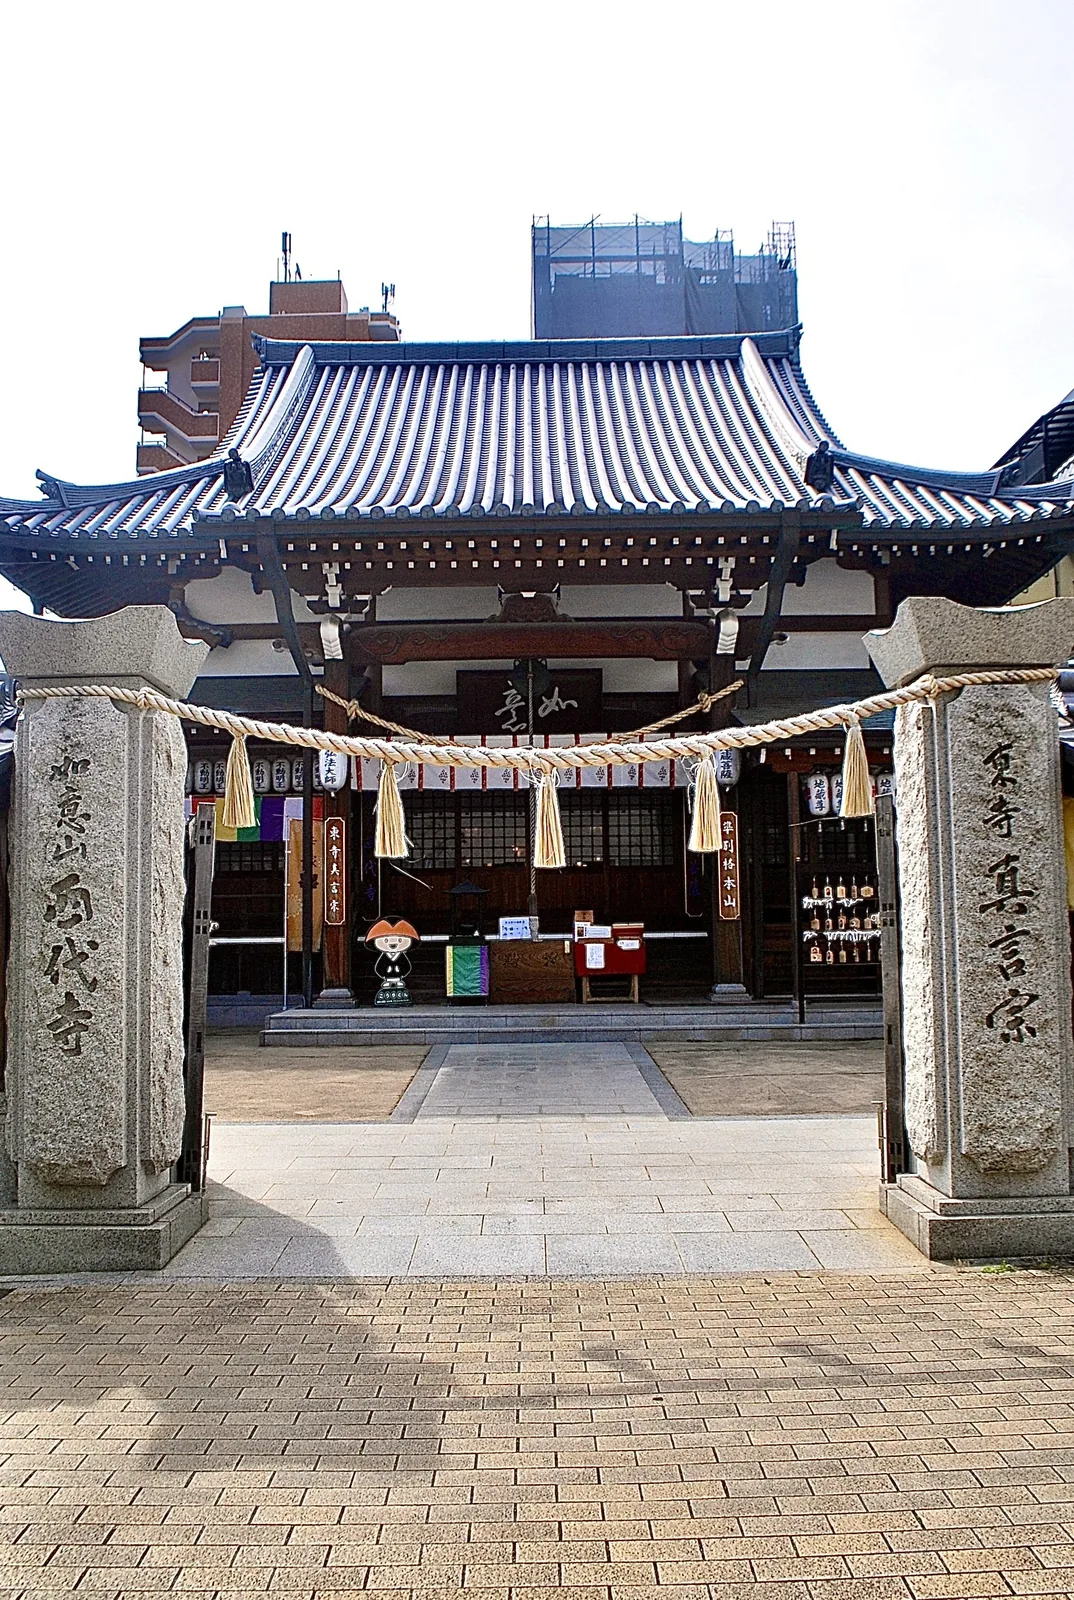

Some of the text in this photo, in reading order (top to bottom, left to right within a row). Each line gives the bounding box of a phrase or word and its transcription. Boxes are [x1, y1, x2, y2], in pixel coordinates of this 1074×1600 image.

[199, 762, 210, 790] 不動明王
[255, 761, 266, 789] 不動明王
[275, 761, 286, 789] 不動明王
[324, 749, 337, 784] 弘法大師
[328, 825, 342, 913] 東寺真言宗
[722, 820, 737, 908] 準別格本山
[978, 740, 1040, 1044] 東寺真言宗
